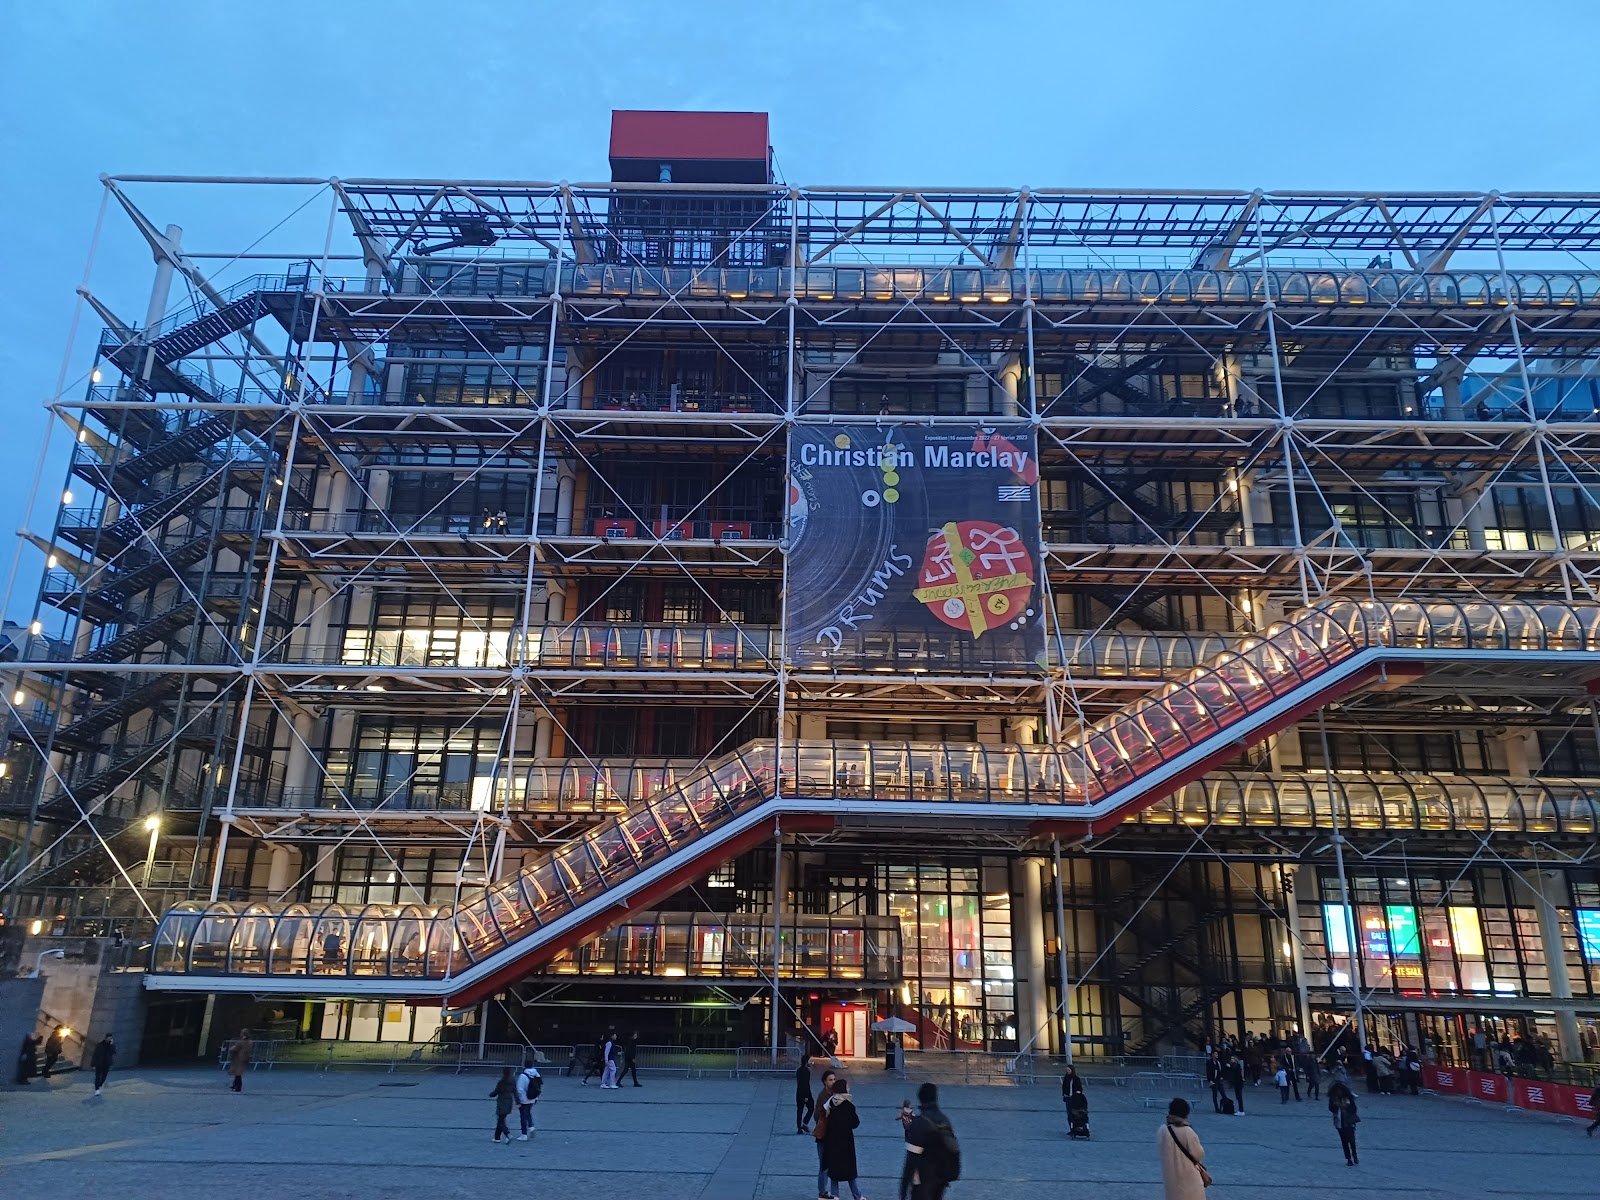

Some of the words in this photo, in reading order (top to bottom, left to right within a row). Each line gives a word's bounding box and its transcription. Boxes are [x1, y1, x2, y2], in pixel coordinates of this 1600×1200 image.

[801, 443, 914, 467] Christian
[924, 446, 1028, 472] Marclay
[816, 544, 913, 651] DRUMS
